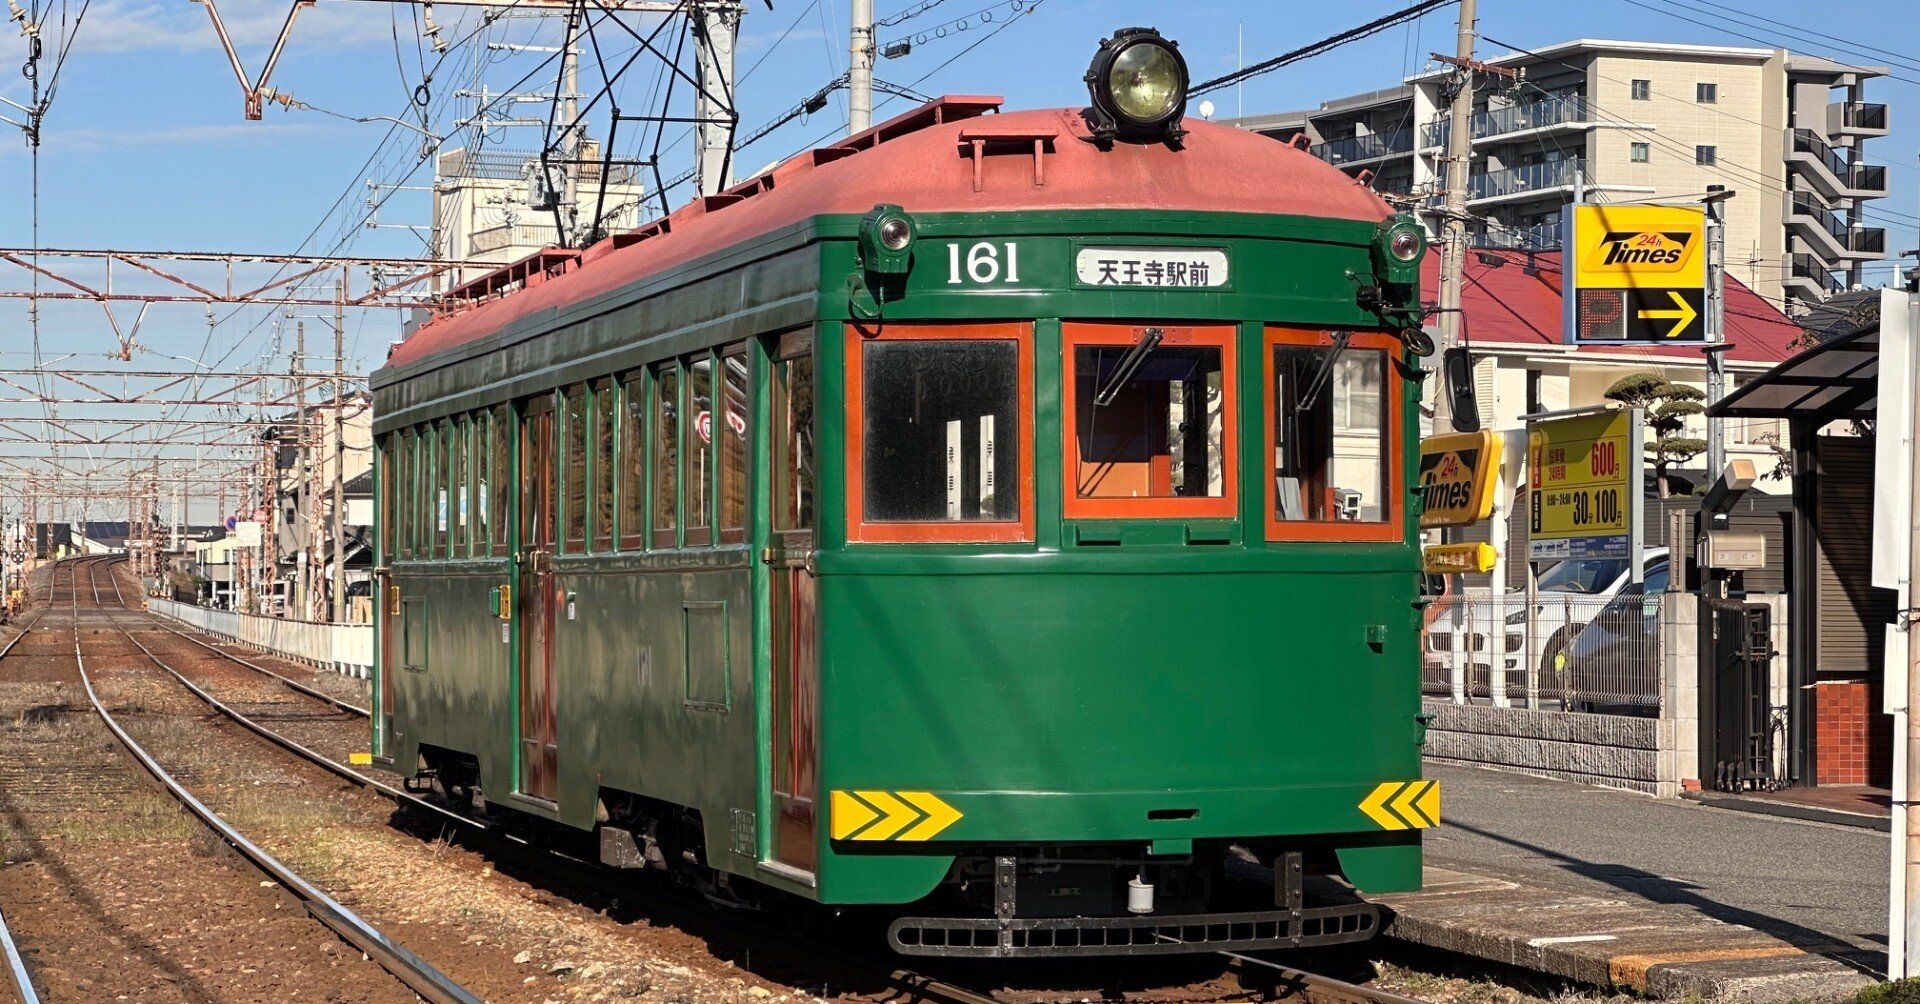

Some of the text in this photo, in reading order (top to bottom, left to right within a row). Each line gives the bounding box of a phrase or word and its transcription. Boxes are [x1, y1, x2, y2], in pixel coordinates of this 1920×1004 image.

[1601, 239, 1683, 266] Times
[1637, 234, 1662, 247] 24h
[947, 242, 1020, 284] 161
[1097, 260, 1209, 286] 天王寺駅前
[1441, 456, 1459, 478] 24h
